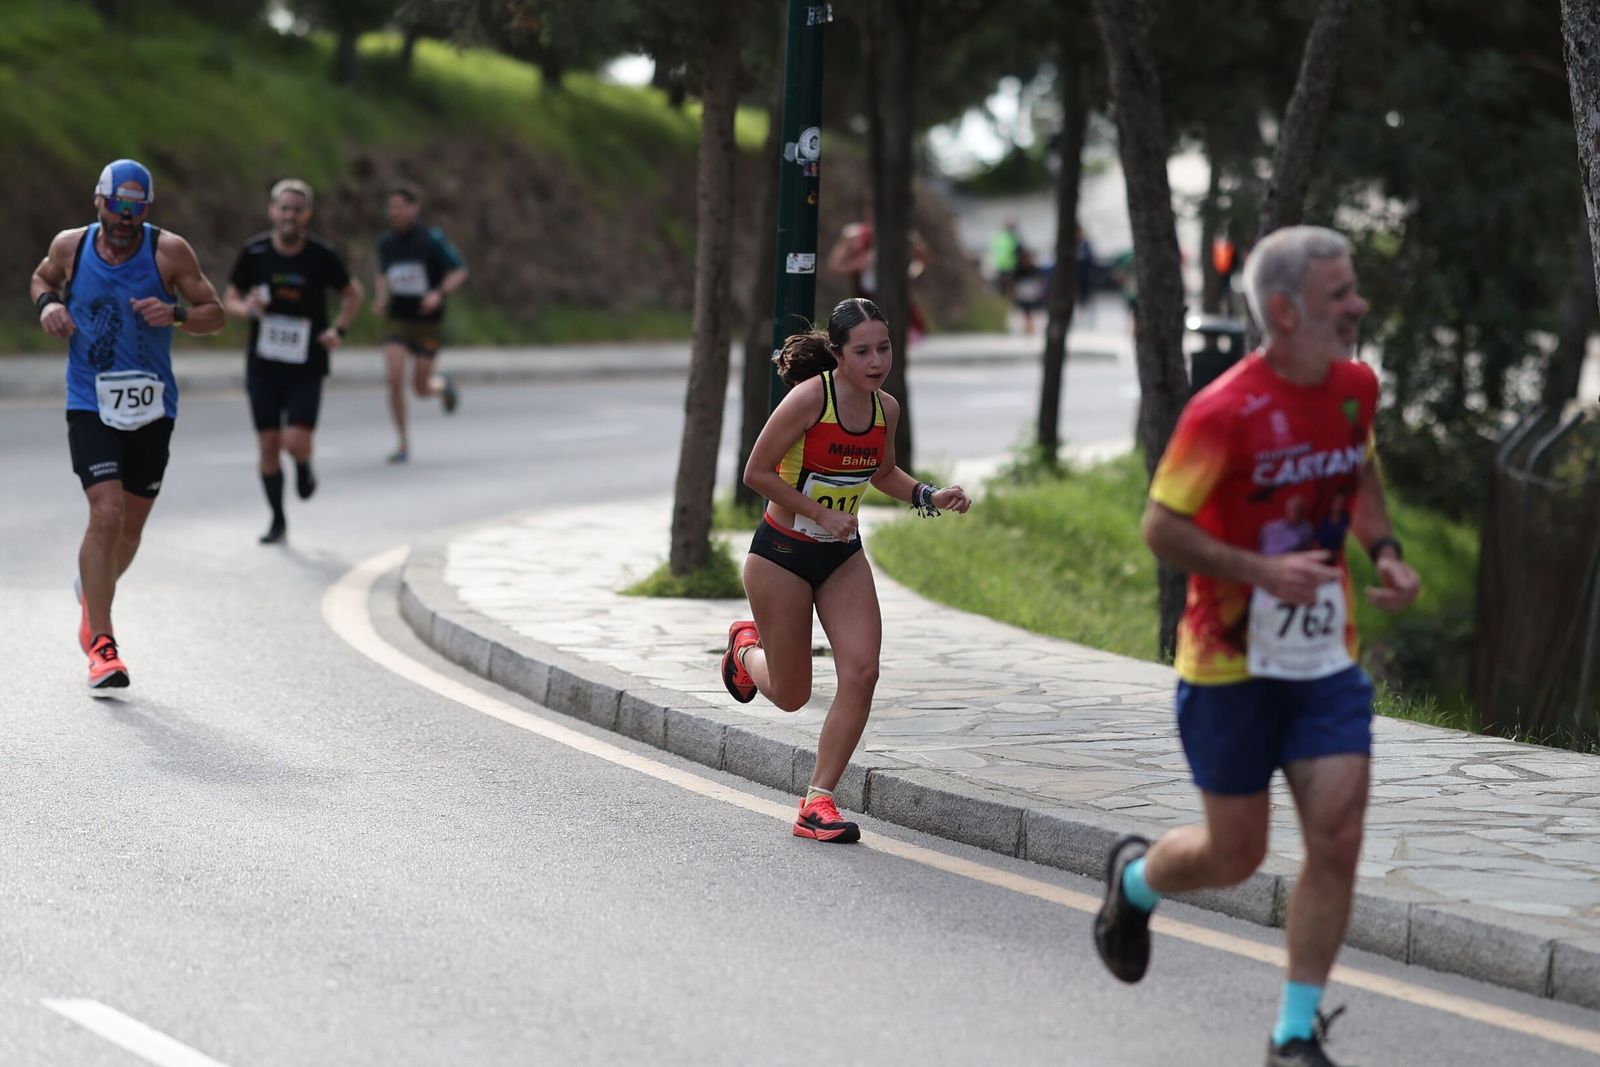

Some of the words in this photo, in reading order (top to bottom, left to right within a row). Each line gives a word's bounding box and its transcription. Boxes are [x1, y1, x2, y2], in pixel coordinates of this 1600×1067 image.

[110, 386, 154, 409] 750
[828, 443, 878, 456] Málaga
[841, 456, 877, 466] Bahía
[1276, 600, 1335, 638] 762
